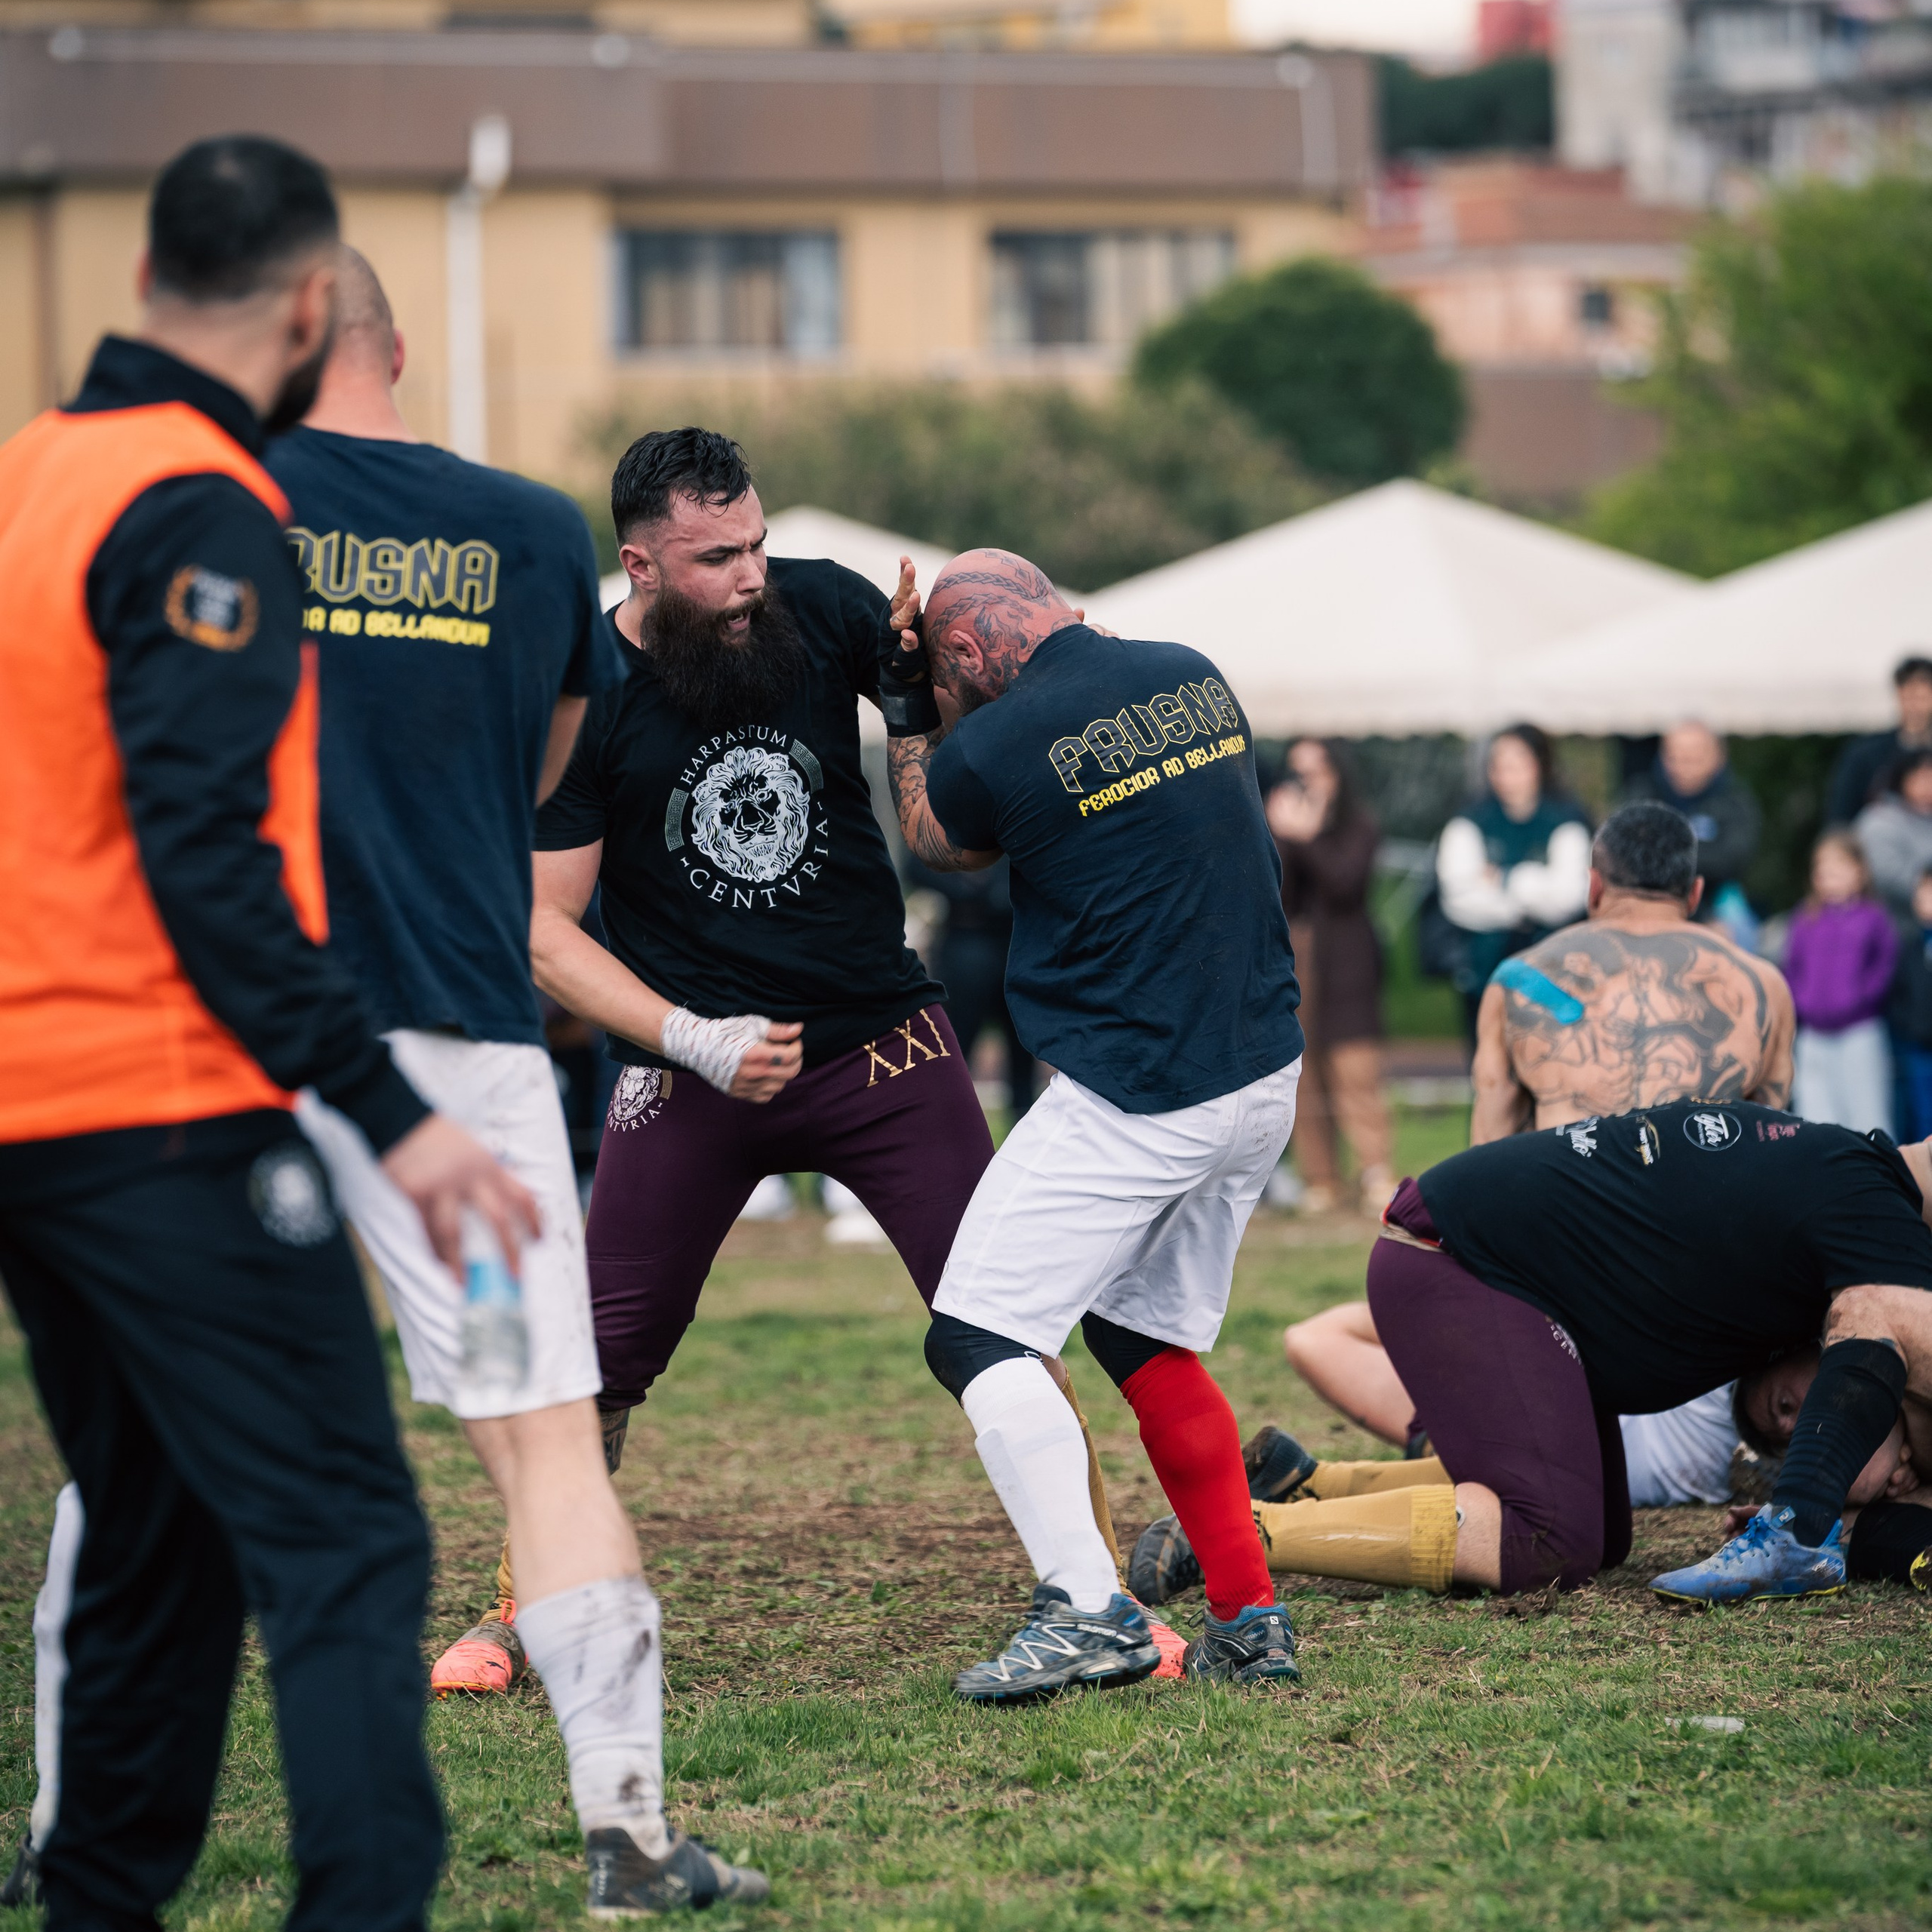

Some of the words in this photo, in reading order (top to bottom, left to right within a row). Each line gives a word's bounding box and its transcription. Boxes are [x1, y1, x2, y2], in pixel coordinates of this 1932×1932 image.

[680, 724, 787, 786] HARPASTUM
[1048, 677, 1238, 792] FRUSNA
[1078, 766, 1161, 817] FEROCIOR
[1161, 756, 1186, 778] AD
[1184, 734, 1246, 770] BELLANDUM
[690, 817, 829, 909] CENTVRIA
[863, 1008, 951, 1088] XXI
